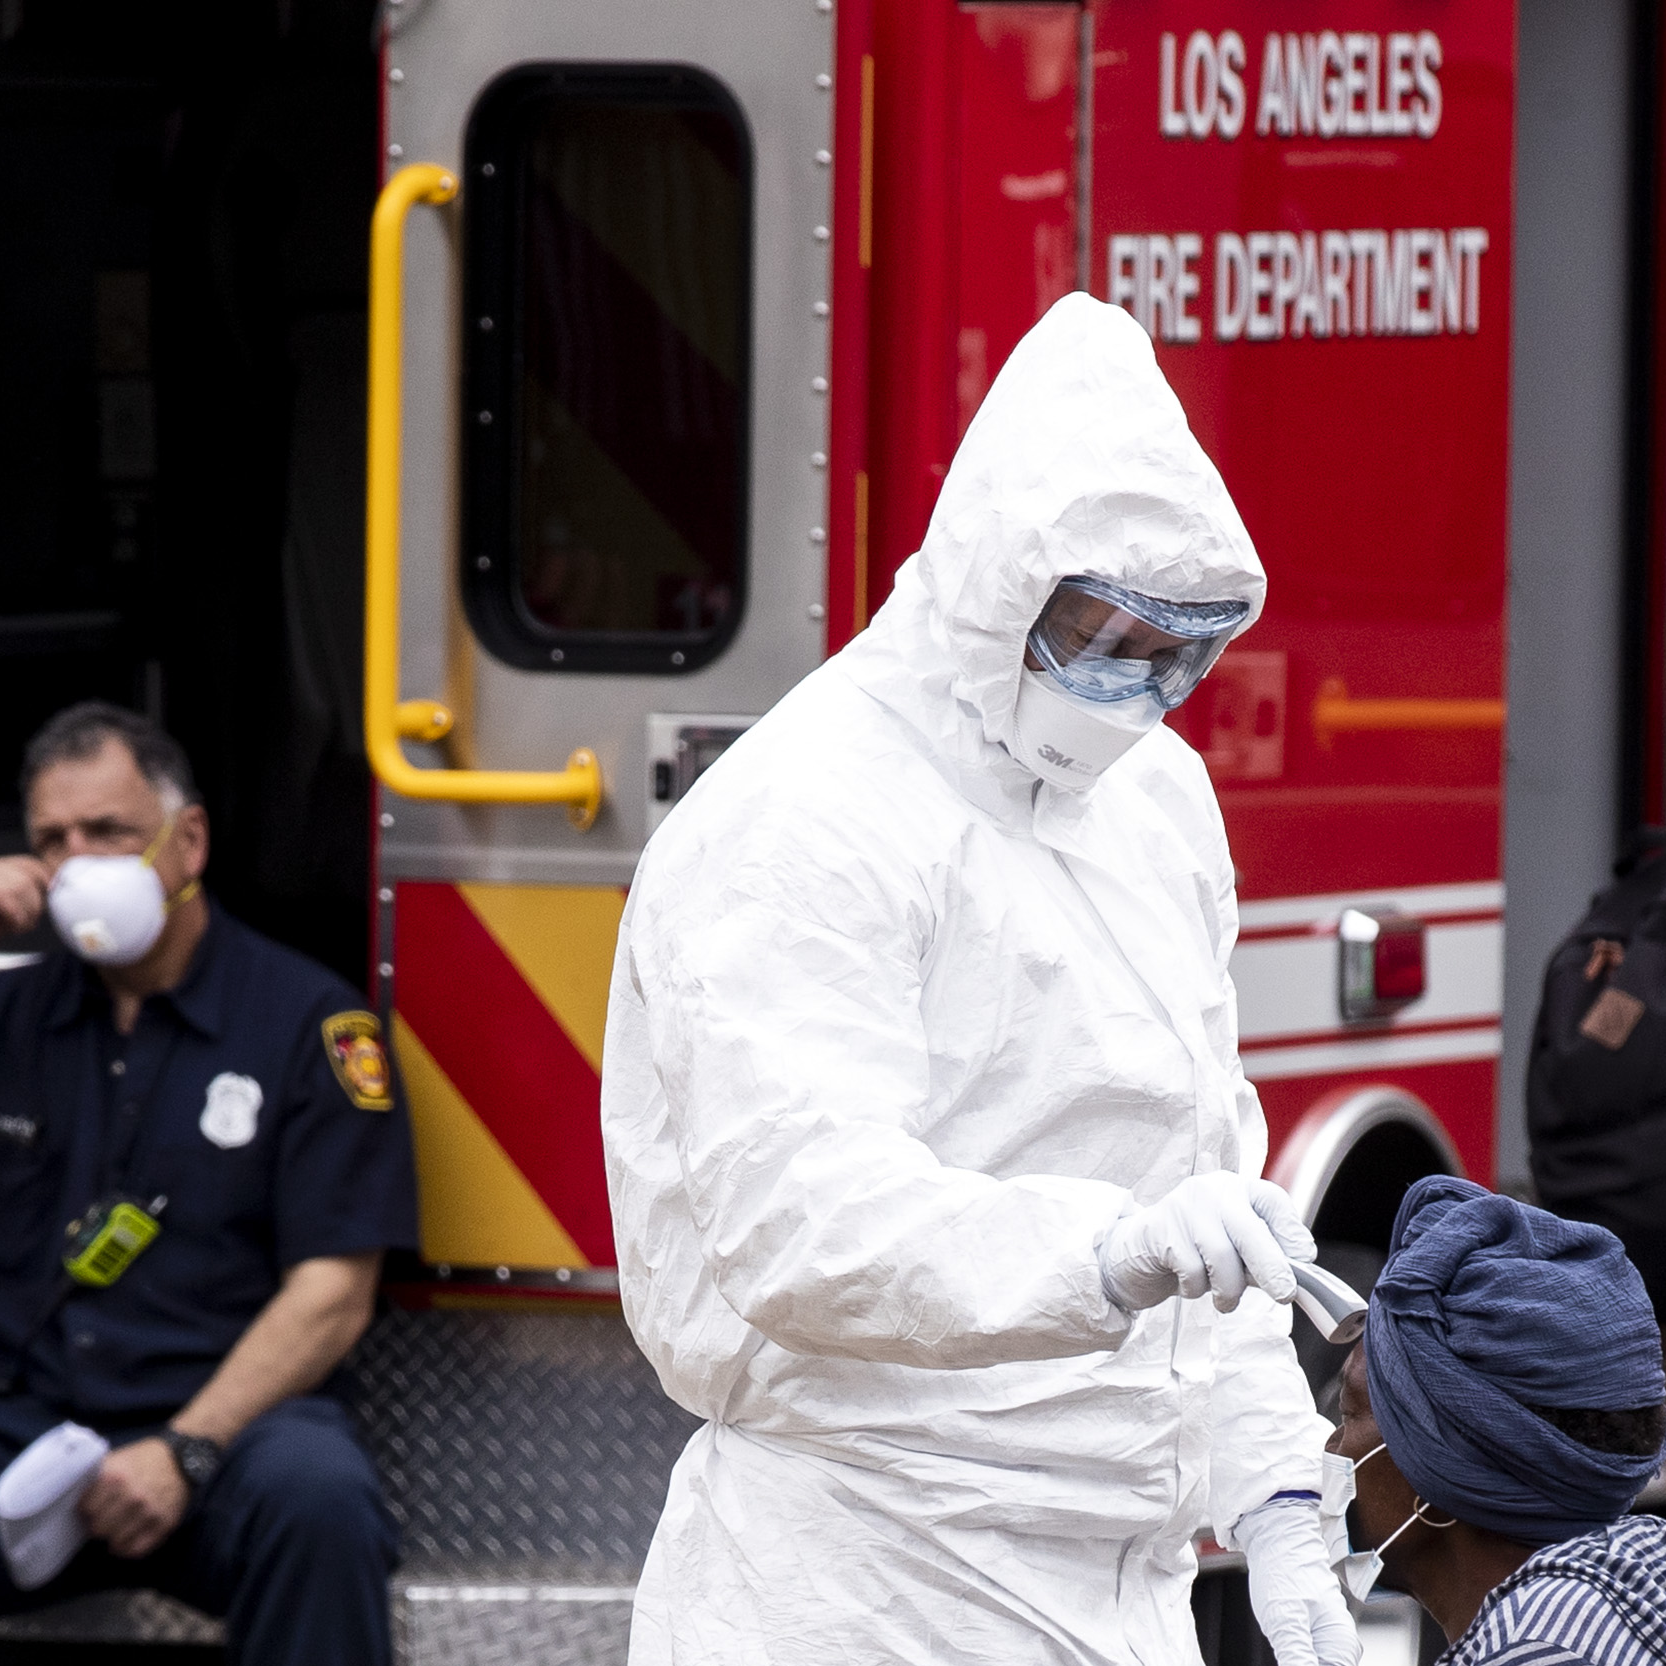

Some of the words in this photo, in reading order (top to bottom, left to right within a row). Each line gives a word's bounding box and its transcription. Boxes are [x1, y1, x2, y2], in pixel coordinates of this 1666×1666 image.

[1159, 29, 1247, 138] LOS
[1255, 29, 1444, 138] ANGELES
[1108, 232, 1203, 343] FIRE
[1213, 227, 1490, 341] DEPARTMENT
[1037, 743, 1075, 769] 3M
